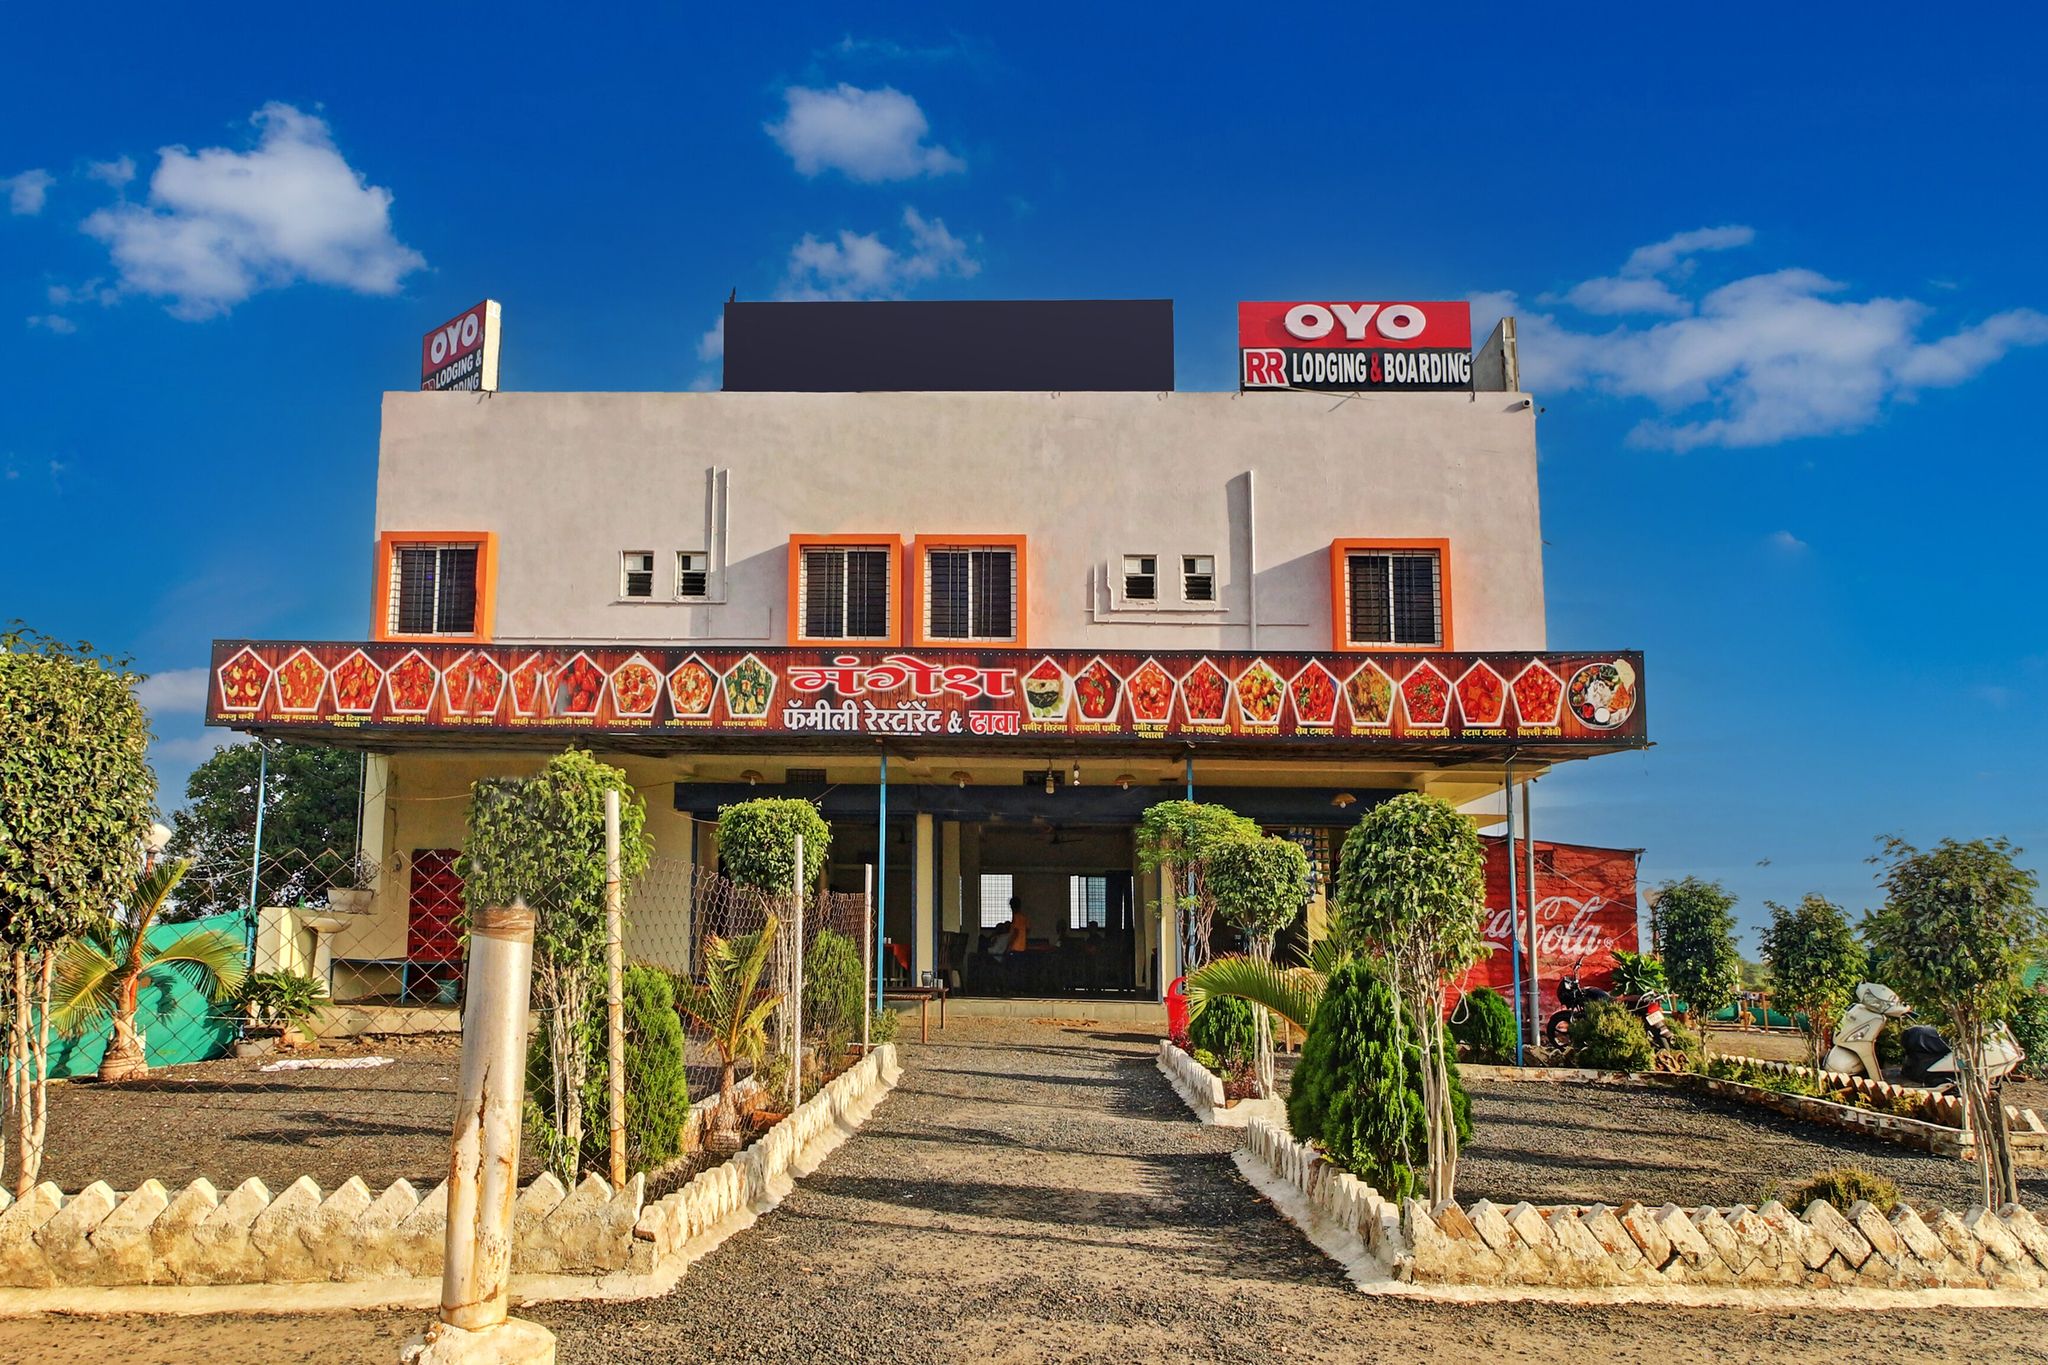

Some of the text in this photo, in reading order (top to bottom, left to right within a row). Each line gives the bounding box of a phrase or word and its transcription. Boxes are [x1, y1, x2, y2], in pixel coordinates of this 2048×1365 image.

[430, 313, 479, 364] OYO
[1284, 303, 1427, 341] OYO
[435, 353, 474, 389] LODGING
[475, 349, 482, 367] &
[1245, 351, 1471, 385] RR LODGING & BOARDING
[787, 654, 1017, 700] मंगेश
[782, 699, 860, 731] फॅमीली
[947, 710, 963, 733] &
